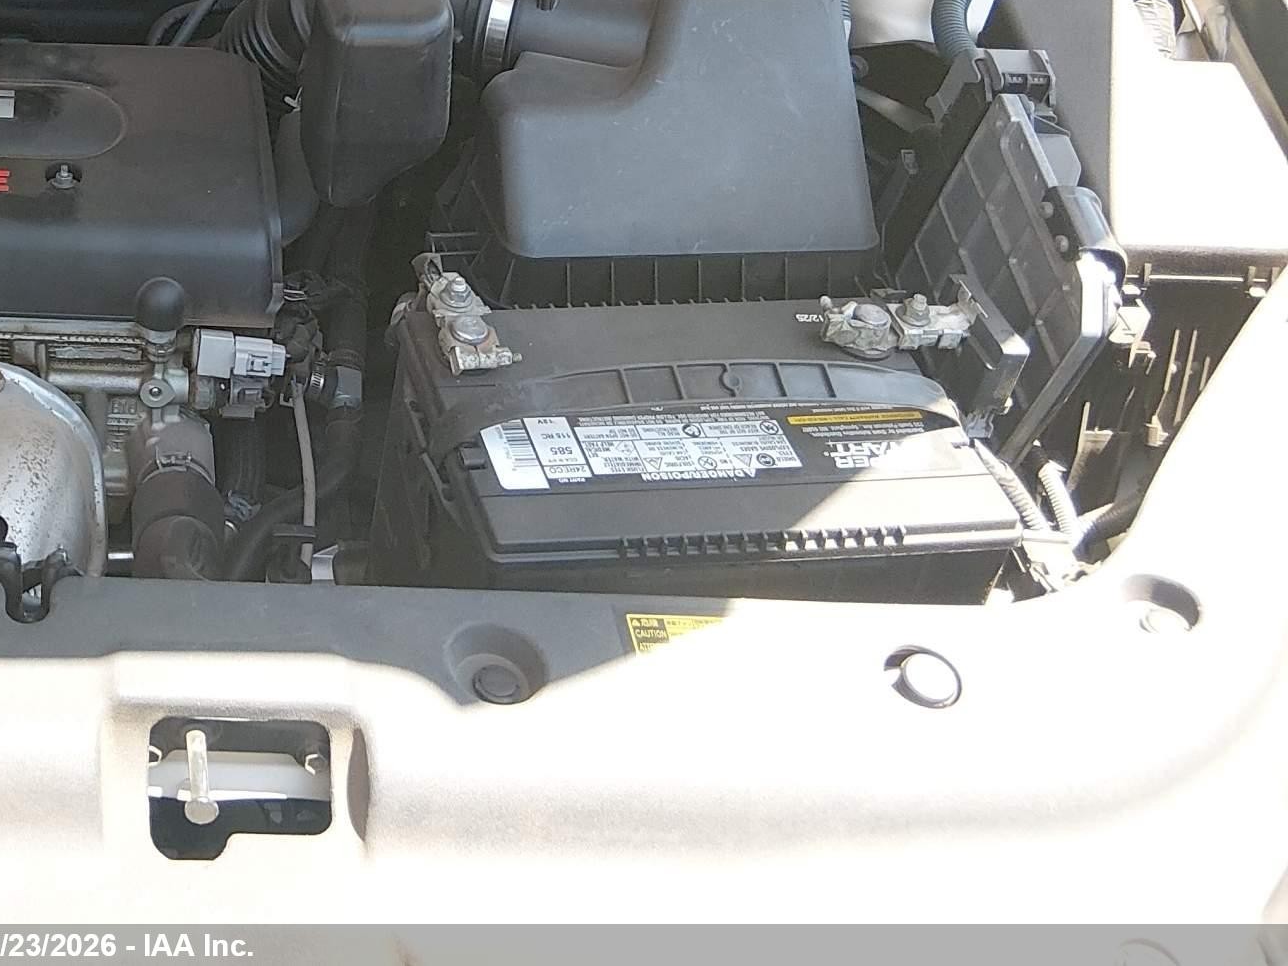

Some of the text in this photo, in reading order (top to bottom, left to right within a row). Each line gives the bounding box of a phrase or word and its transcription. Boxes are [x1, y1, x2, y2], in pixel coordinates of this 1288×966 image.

[550, 446, 572, 456] 585
[641, 469, 745, 481] DANGER/POISON
[635, 629, 668, 639] CAUTION
